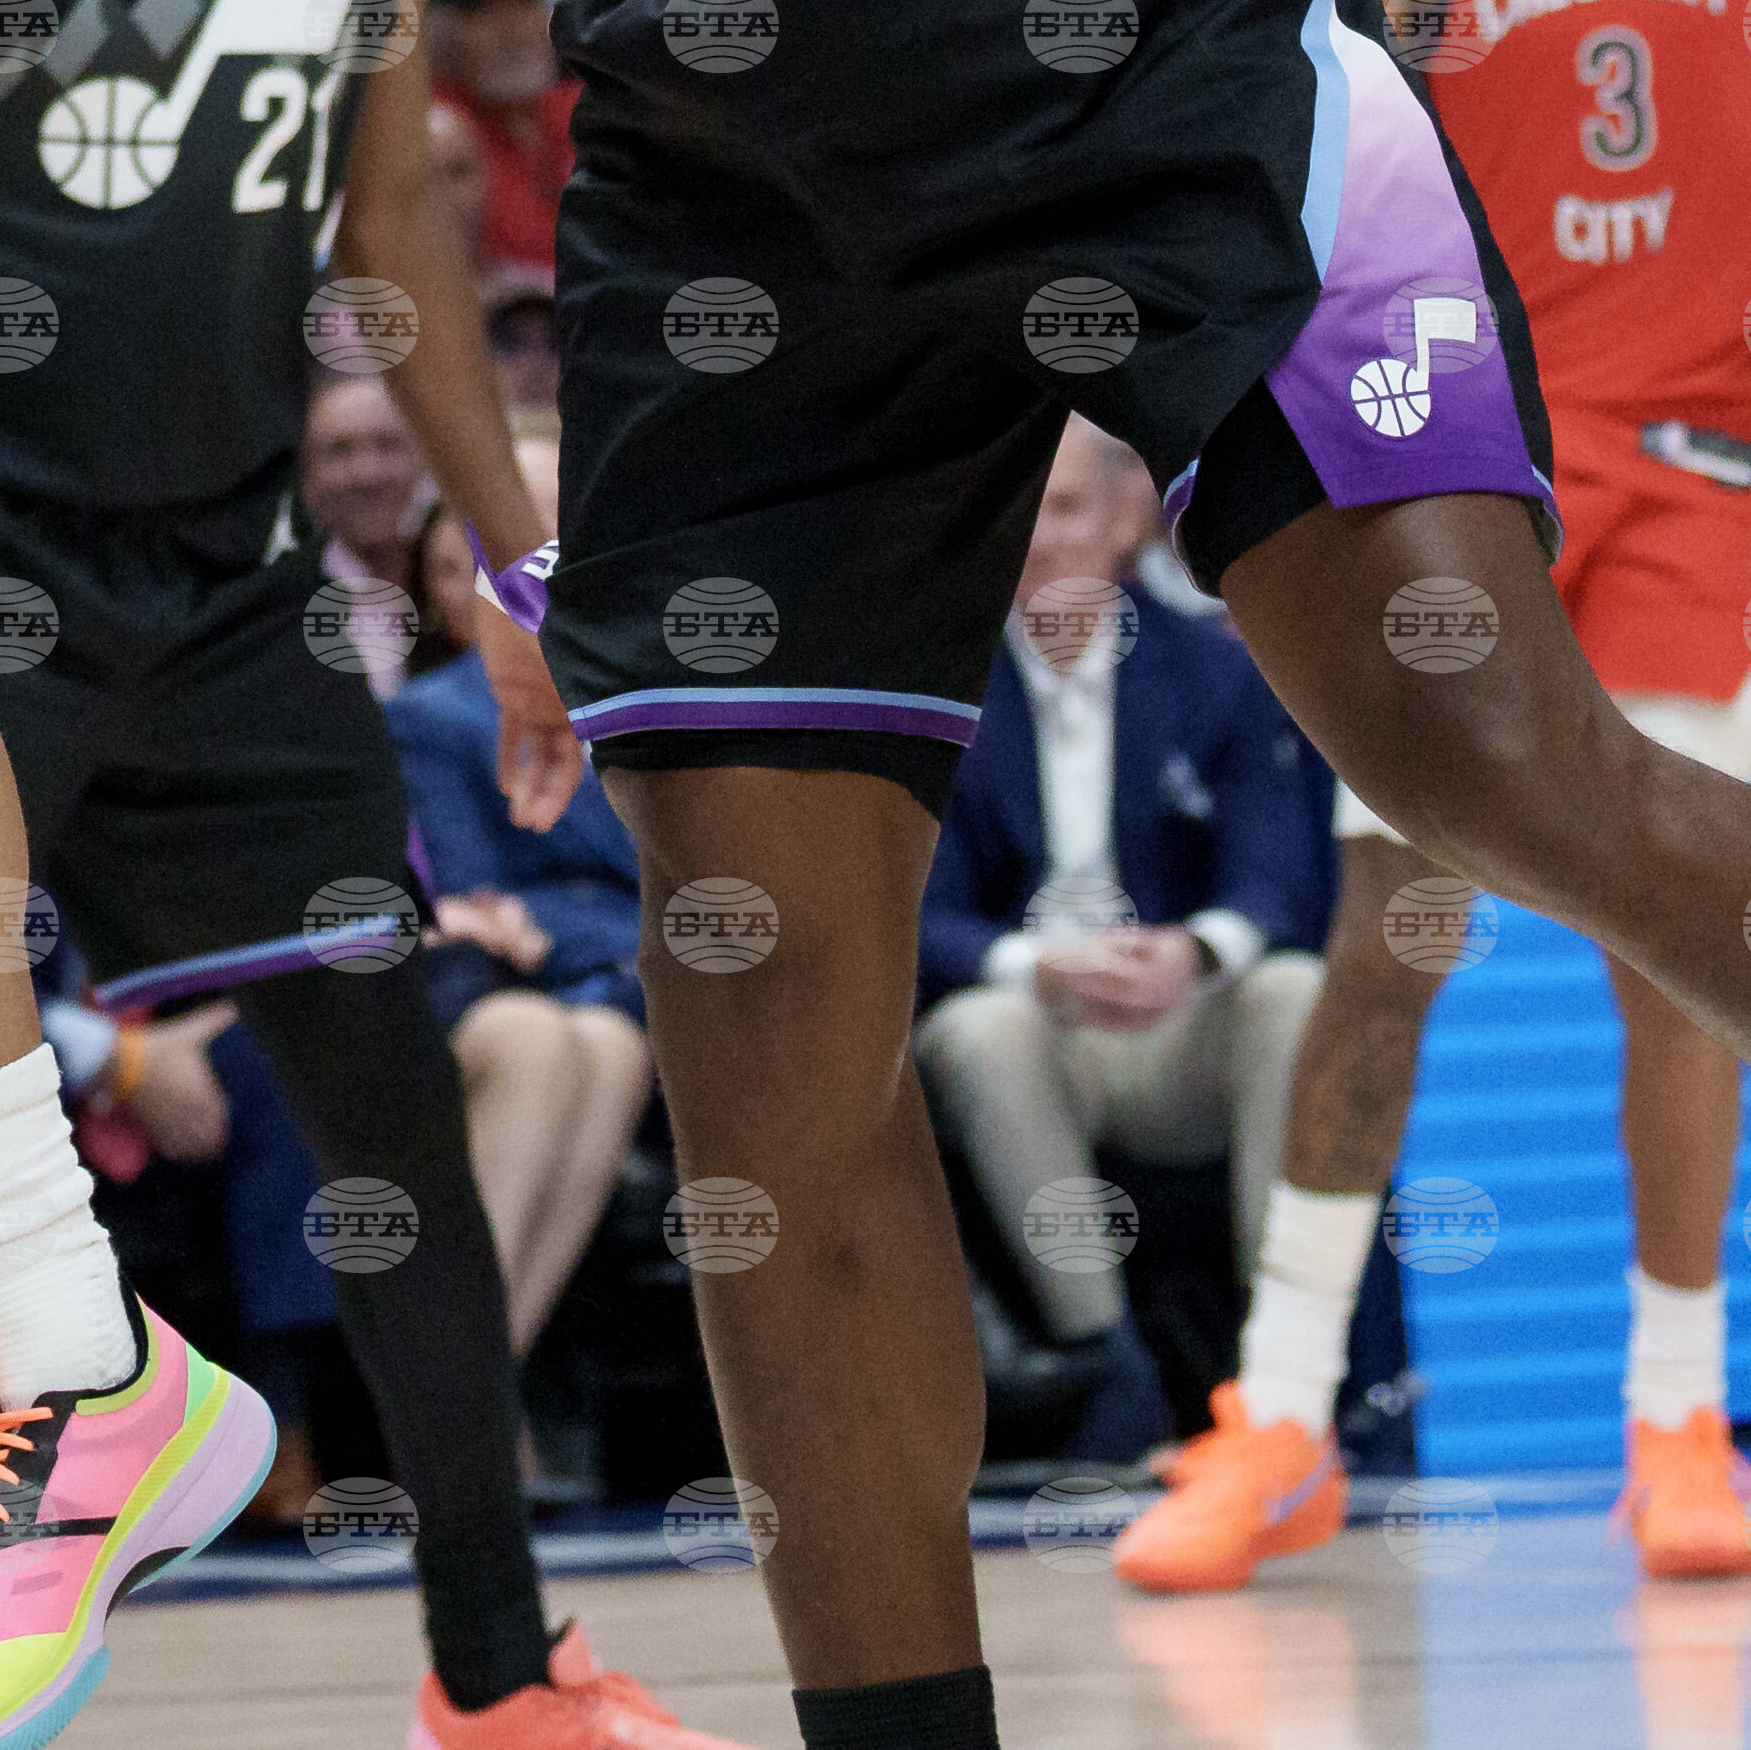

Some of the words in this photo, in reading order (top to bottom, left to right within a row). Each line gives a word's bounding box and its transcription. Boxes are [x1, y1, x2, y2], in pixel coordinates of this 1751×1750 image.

[233, 66, 336, 214] 21
[1574, 24, 1657, 173] 3
[1553, 185, 1676, 266] CITY
